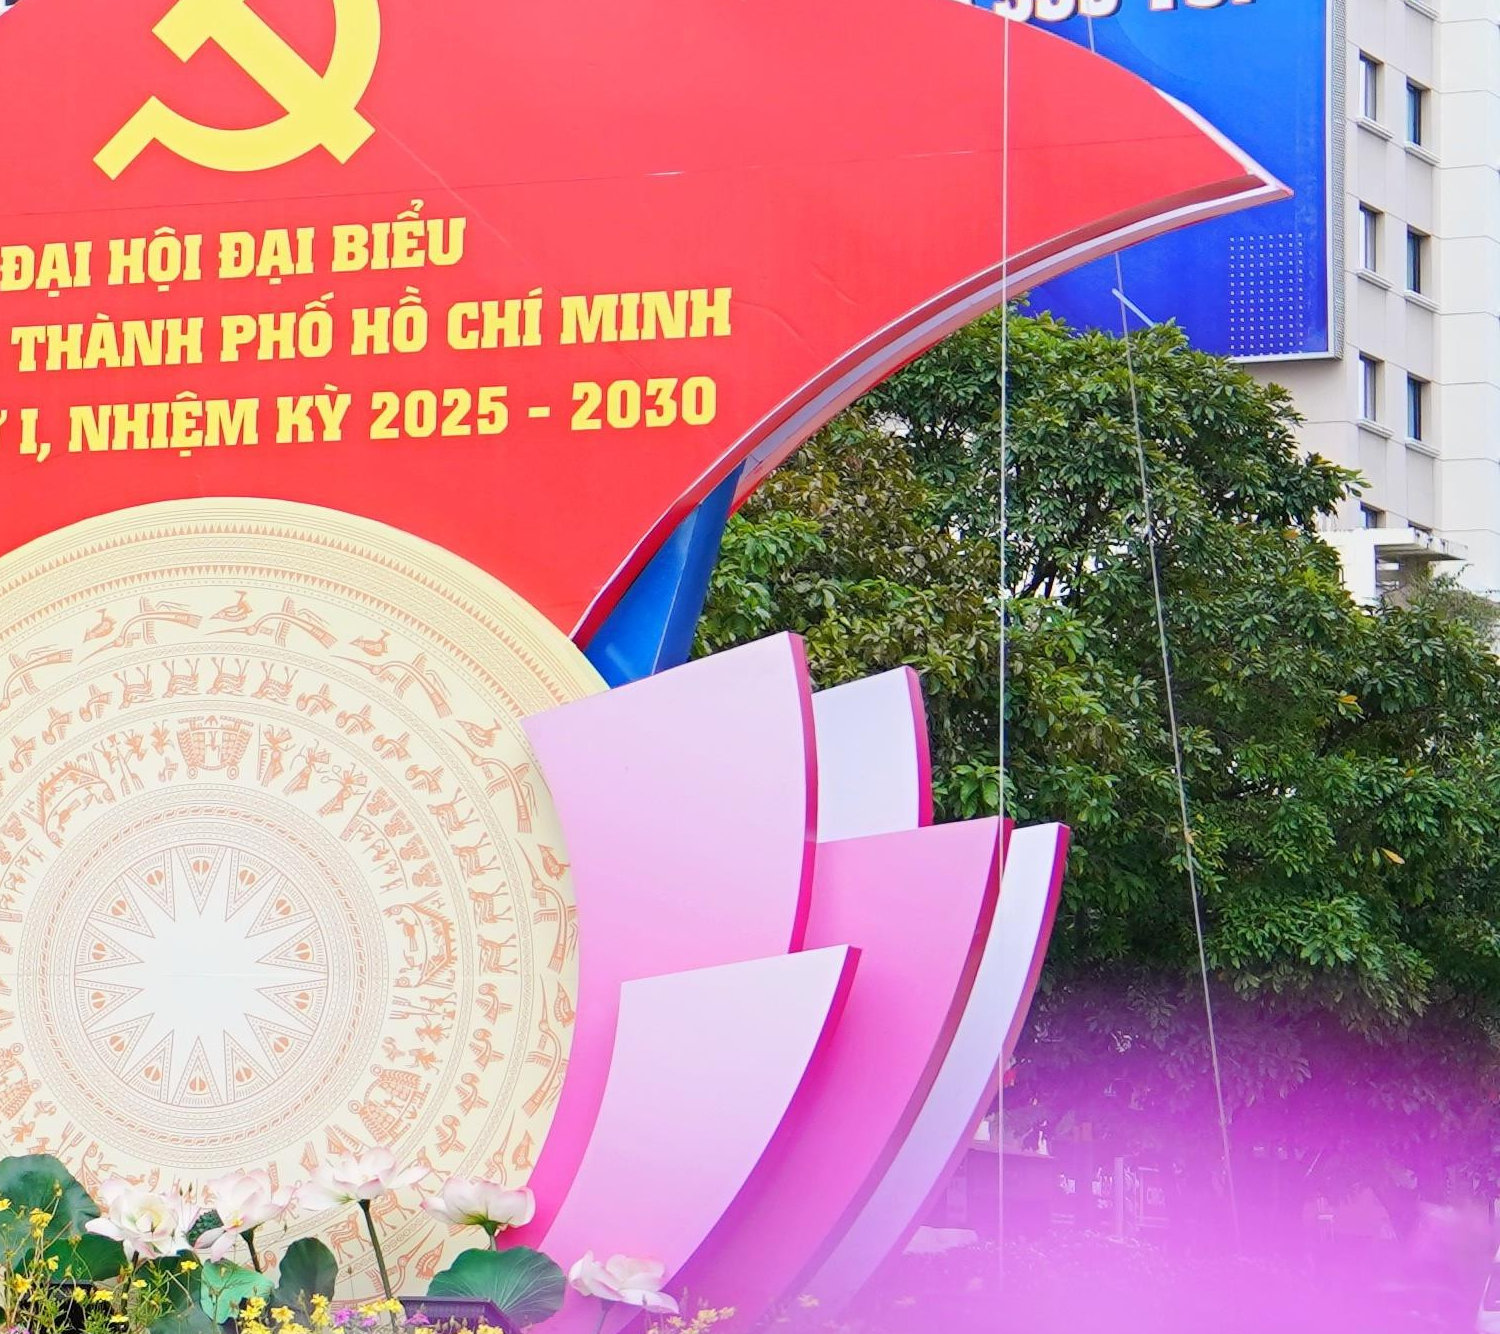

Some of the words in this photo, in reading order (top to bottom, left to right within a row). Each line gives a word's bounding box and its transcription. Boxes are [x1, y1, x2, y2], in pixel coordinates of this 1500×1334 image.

[0, 239, 93, 298] ĐẠI
[107, 225, 203, 292] HỘI
[218, 225, 315, 285] ĐẠI
[331, 197, 467, 273] BIỂU
[10, 311, 204, 373] THÀNH
[219, 290, 334, 363] PHỐ
[350, 284, 428, 356] HỒ
[447, 286, 543, 350] CHÍ
[559, 286, 733, 345] MINH
[19, 406, 52, 463] I,
[68, 389, 260, 458] NHIỆM
[275, 382, 352, 444] KỲ
[369, 384, 509, 440] 2025
[570, 374, 717, 431] 2030
